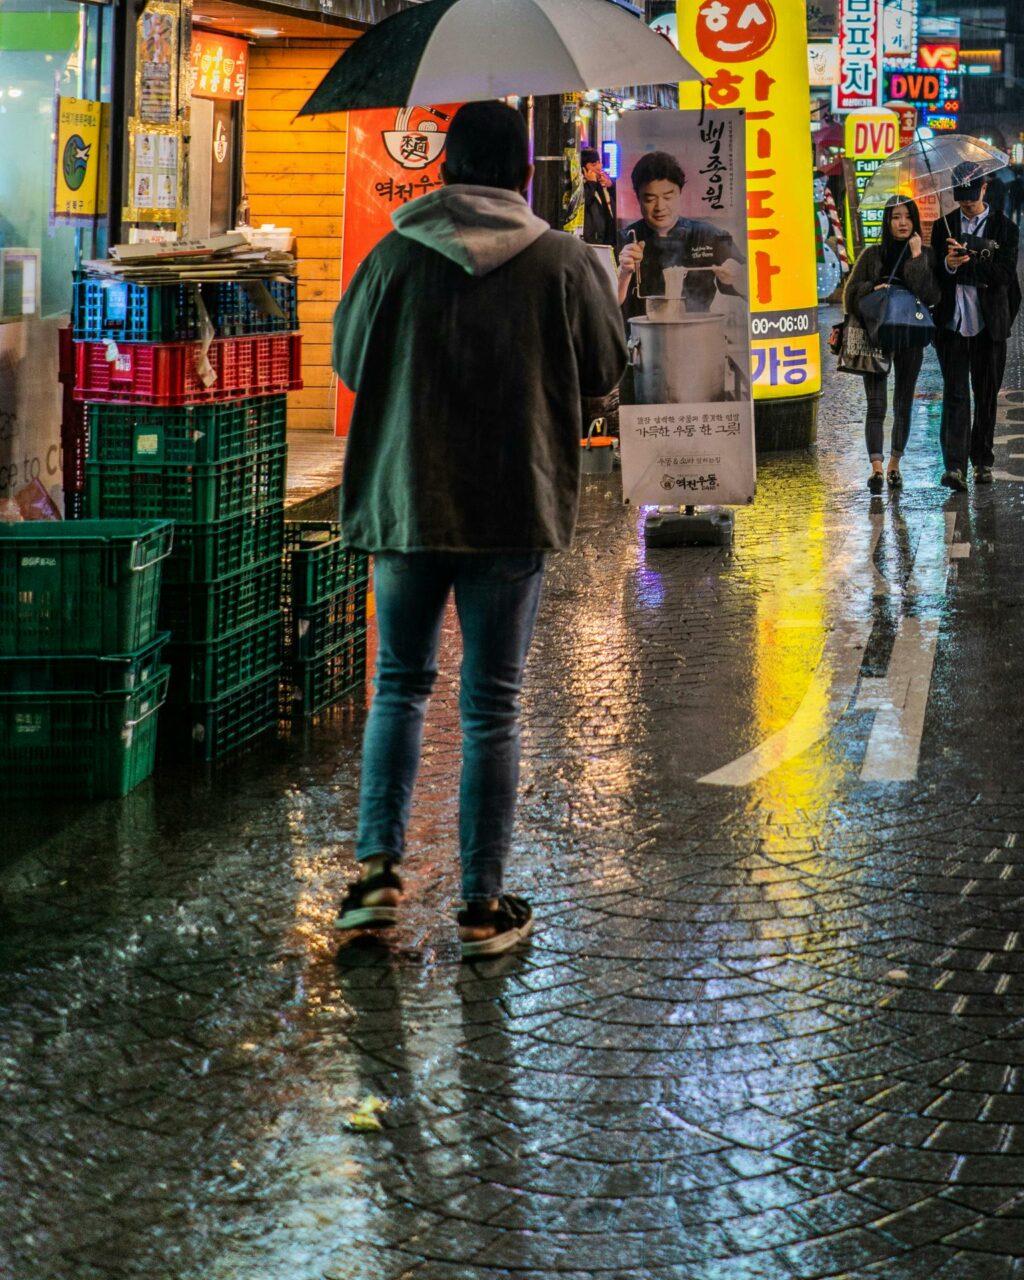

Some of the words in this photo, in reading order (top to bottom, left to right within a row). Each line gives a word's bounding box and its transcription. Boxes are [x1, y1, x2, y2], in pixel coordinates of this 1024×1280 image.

[890, 74, 940, 99] DVD
[854, 122, 896, 154] DVD
[699, 120, 727, 210] 백종원
[751, 345, 808, 387] 가능
[635, 424, 670, 439] 가득한
[673, 424, 697, 438] 우동
[700, 424, 712, 436] 한
[675, 473, 718, 491] 역전우동
